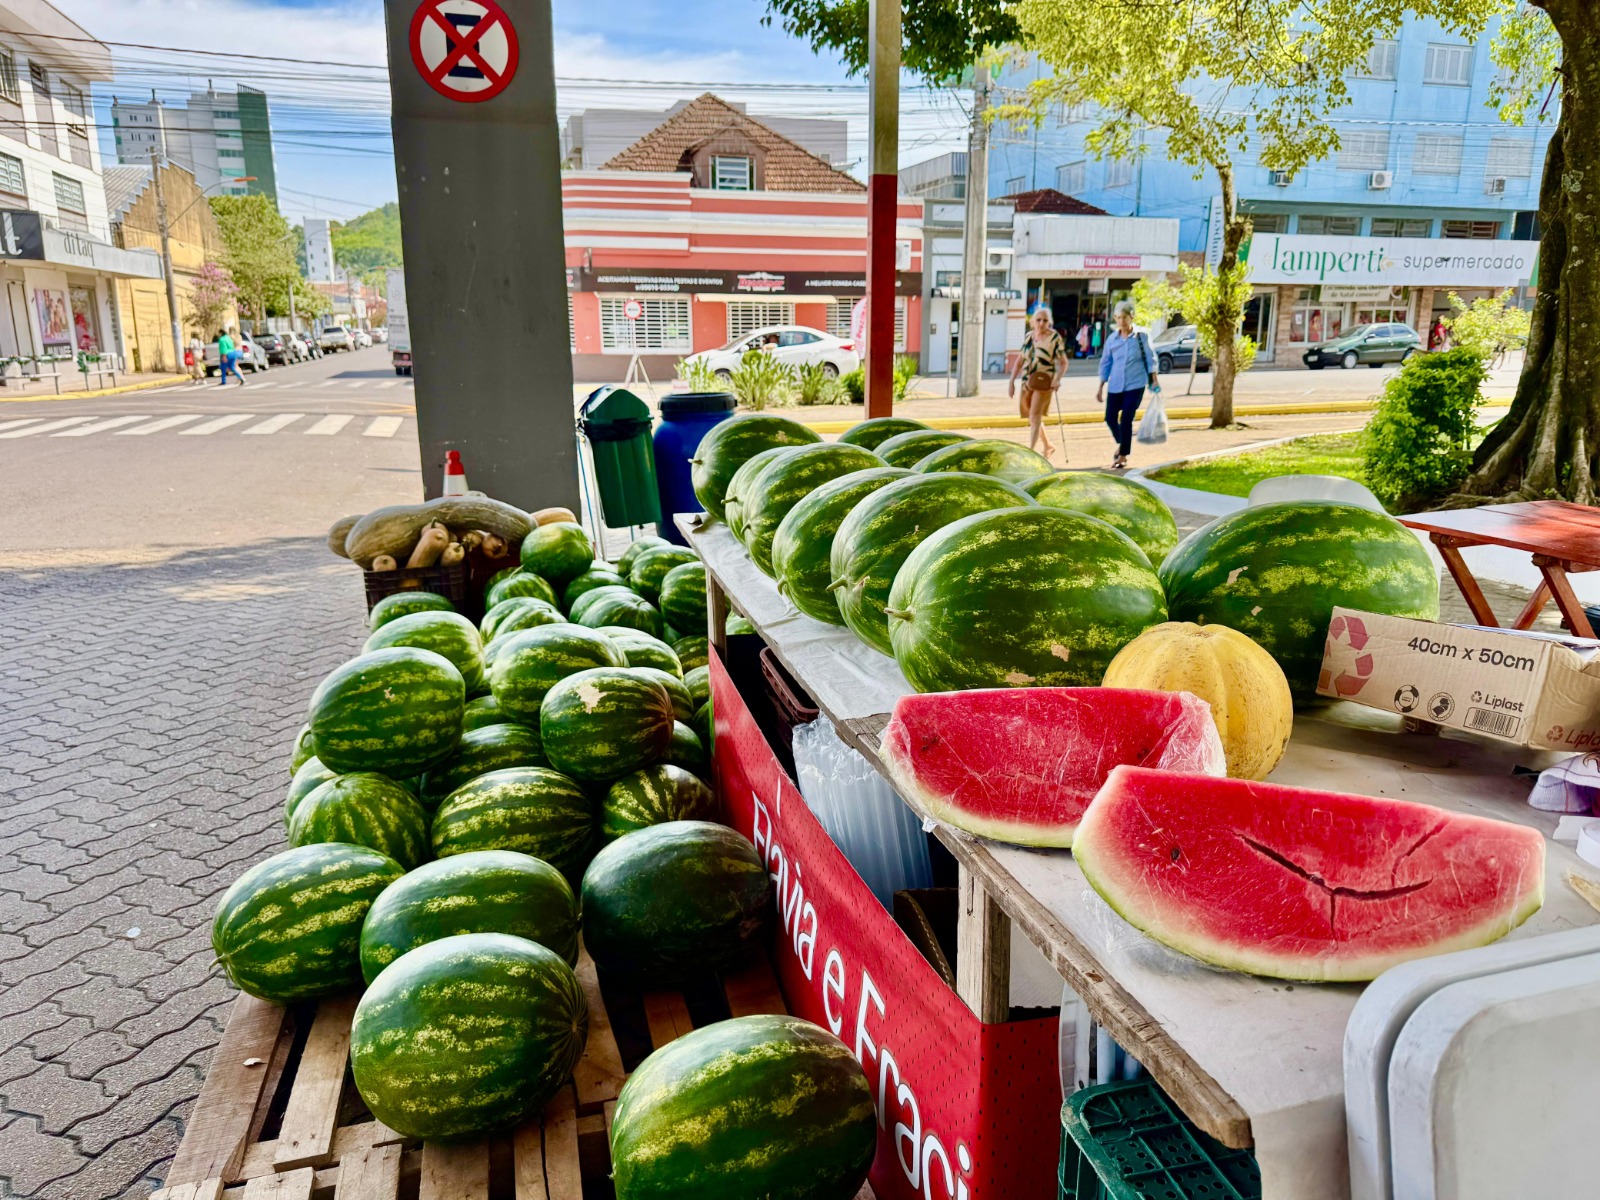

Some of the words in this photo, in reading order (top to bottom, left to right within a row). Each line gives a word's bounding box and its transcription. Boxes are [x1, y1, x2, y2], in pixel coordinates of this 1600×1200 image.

[1403, 254, 1524, 271] supermercado
[1407, 637, 1457, 658] 40cm
[1461, 647, 1473, 661] x
[1478, 648, 1535, 672] 50cm
[1484, 693, 1525, 713] Liplast
[822, 949, 845, 1036] e
